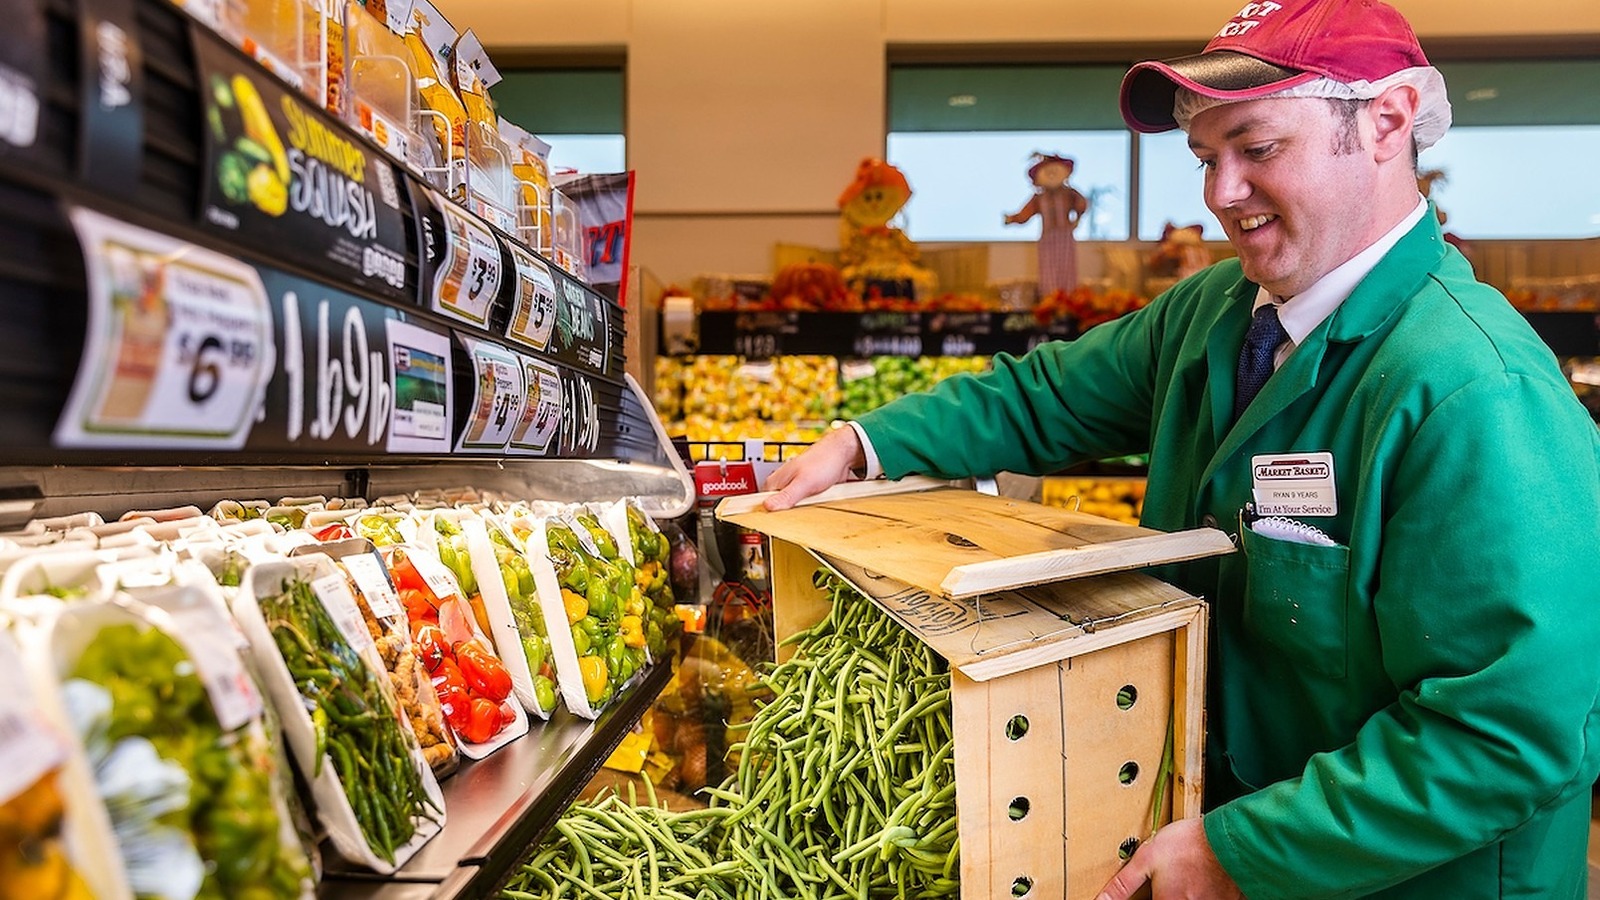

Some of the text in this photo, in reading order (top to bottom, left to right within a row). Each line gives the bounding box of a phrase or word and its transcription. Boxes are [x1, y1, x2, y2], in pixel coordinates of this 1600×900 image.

[287, 147, 378, 240] SQUASH
[1260, 466, 1325, 477] MARKET BASKET
[702, 477, 749, 495] goodcook
[1272, 491, 1291, 499] RYAN
[1297, 491, 1319, 499] YEARS
[1259, 504, 1332, 514] I'm At Your Service
